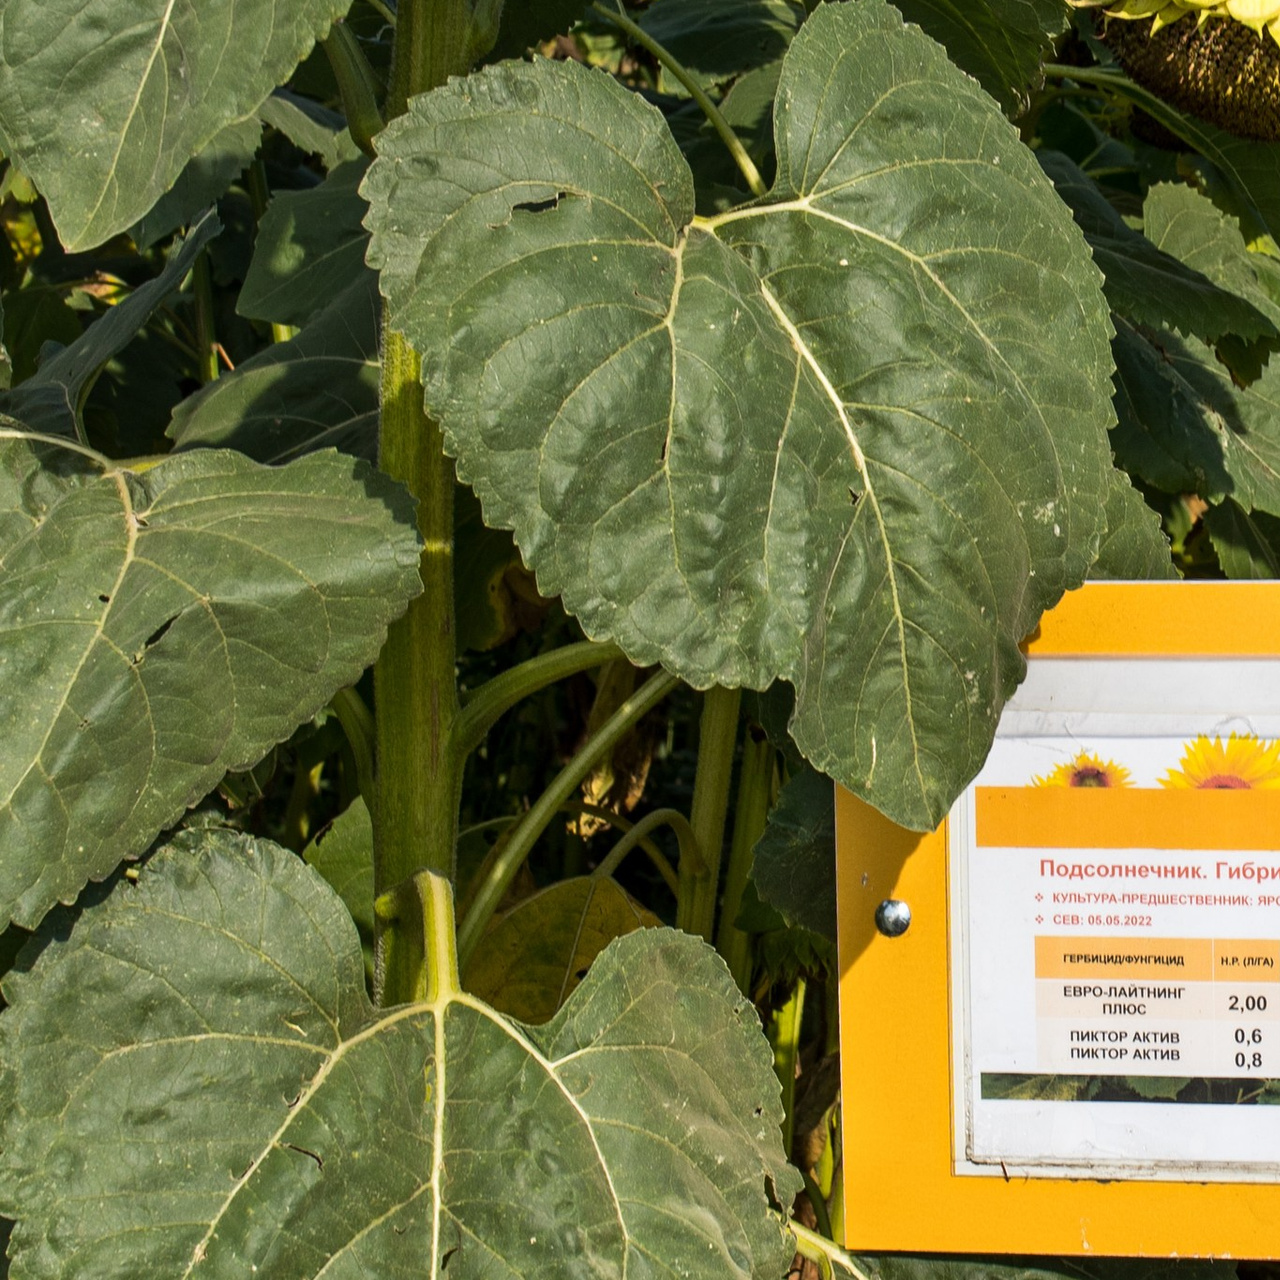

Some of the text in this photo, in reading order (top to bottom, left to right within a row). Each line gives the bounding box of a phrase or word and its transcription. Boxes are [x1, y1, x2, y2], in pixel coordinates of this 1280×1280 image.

[1040, 859, 1207, 881] Подсолнечник.
[1052, 892, 1253, 907] КУЛЬТУРА-ПРЕДШЕСТВЕННИК:
[1052, 914, 1152, 927] СЕВ: 05.05.2022
[1063, 953, 1185, 967] ГЕРБИЦИД/ФУНГИЦИД
[1220, 956, 1274, 969] Н.Р. (Л/ГА)
[1063, 983, 1186, 1000] ЕВРО-ЛАЙТНИНГ
[1102, 1003, 1147, 1016] ПЛЮС
[1228, 994, 1268, 1014] 2,00
[1070, 1030, 1181, 1045] ПИКТОР АКТИВ
[1234, 1028, 1263, 1047] 0,6
[1070, 1047, 1181, 1061] ПИКТОР АКТИВ
[1234, 1051, 1263, 1071] 0,8
